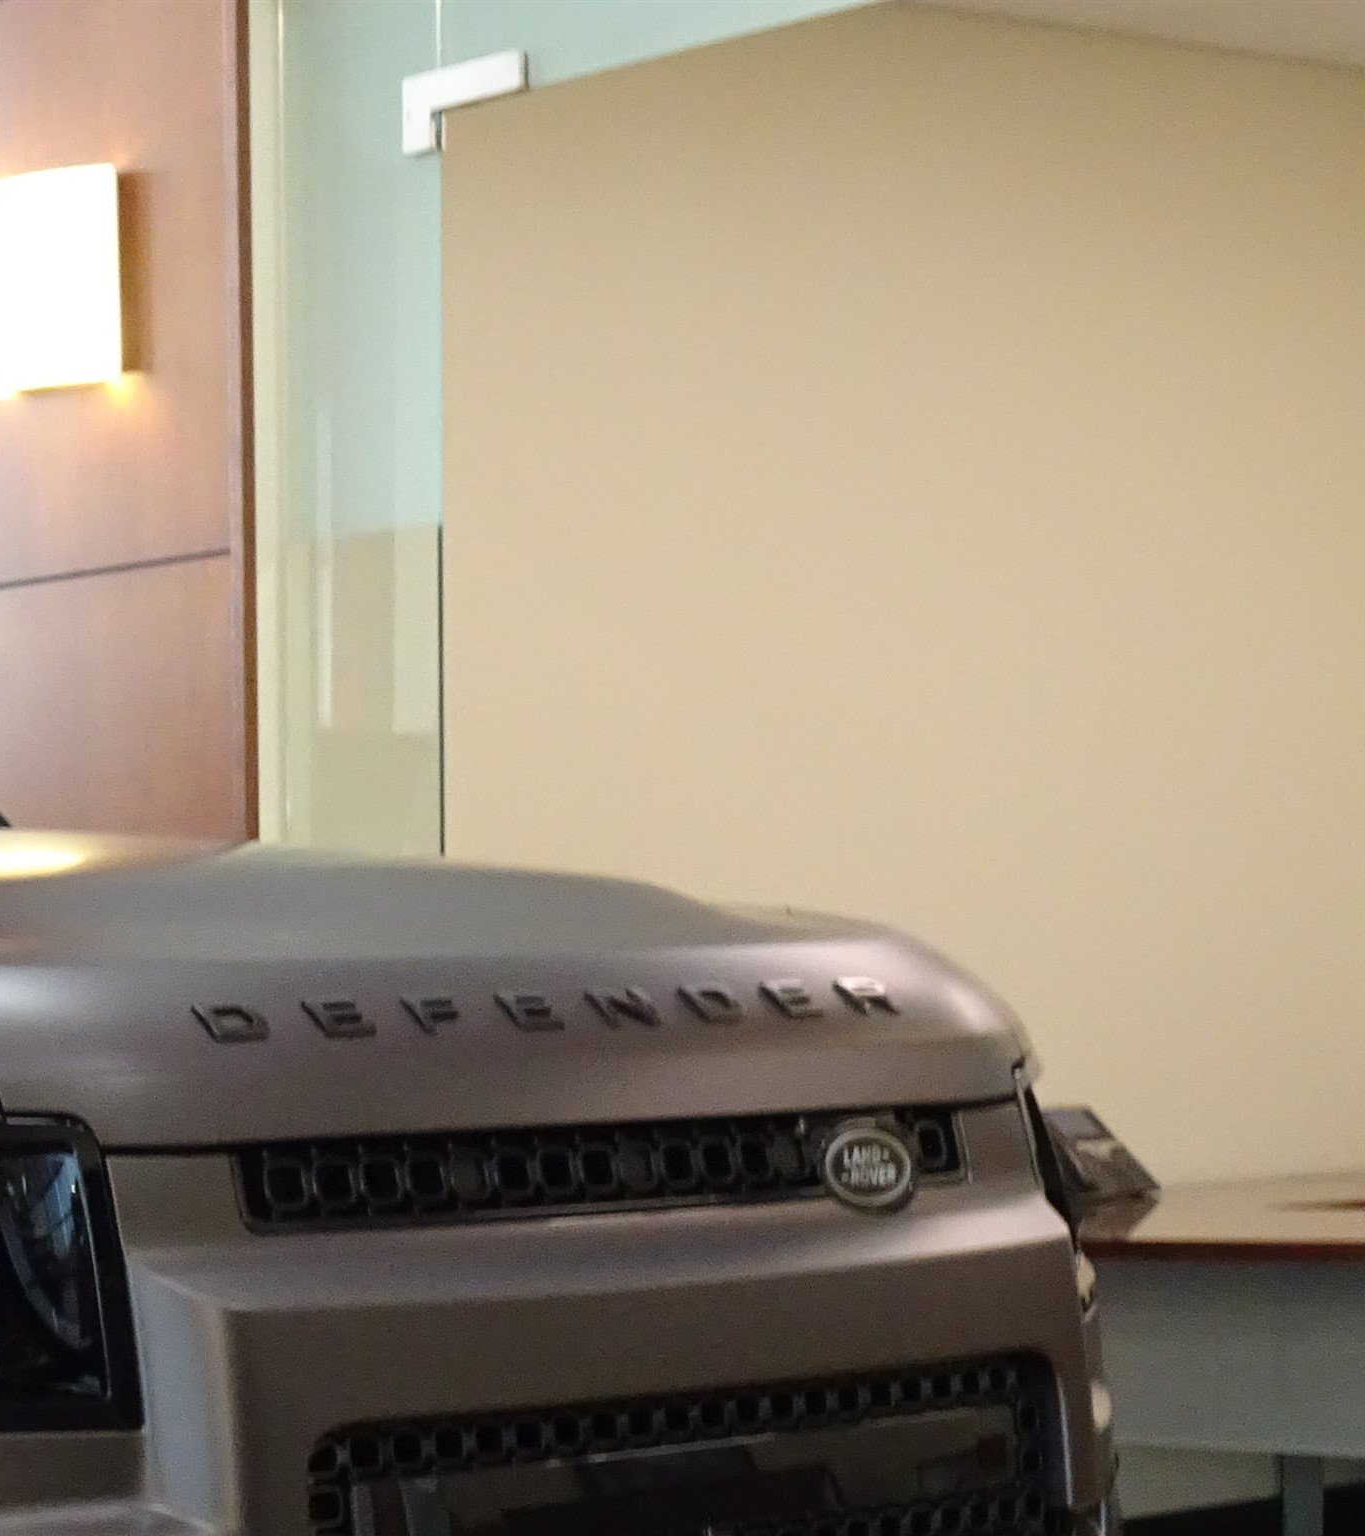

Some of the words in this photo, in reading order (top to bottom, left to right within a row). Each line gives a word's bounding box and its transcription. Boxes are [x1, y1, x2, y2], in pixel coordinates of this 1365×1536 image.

[191, 976, 900, 1043] DEFENDER
[842, 1144, 882, 1169] LAND
[850, 1161, 897, 1188] ROVER
